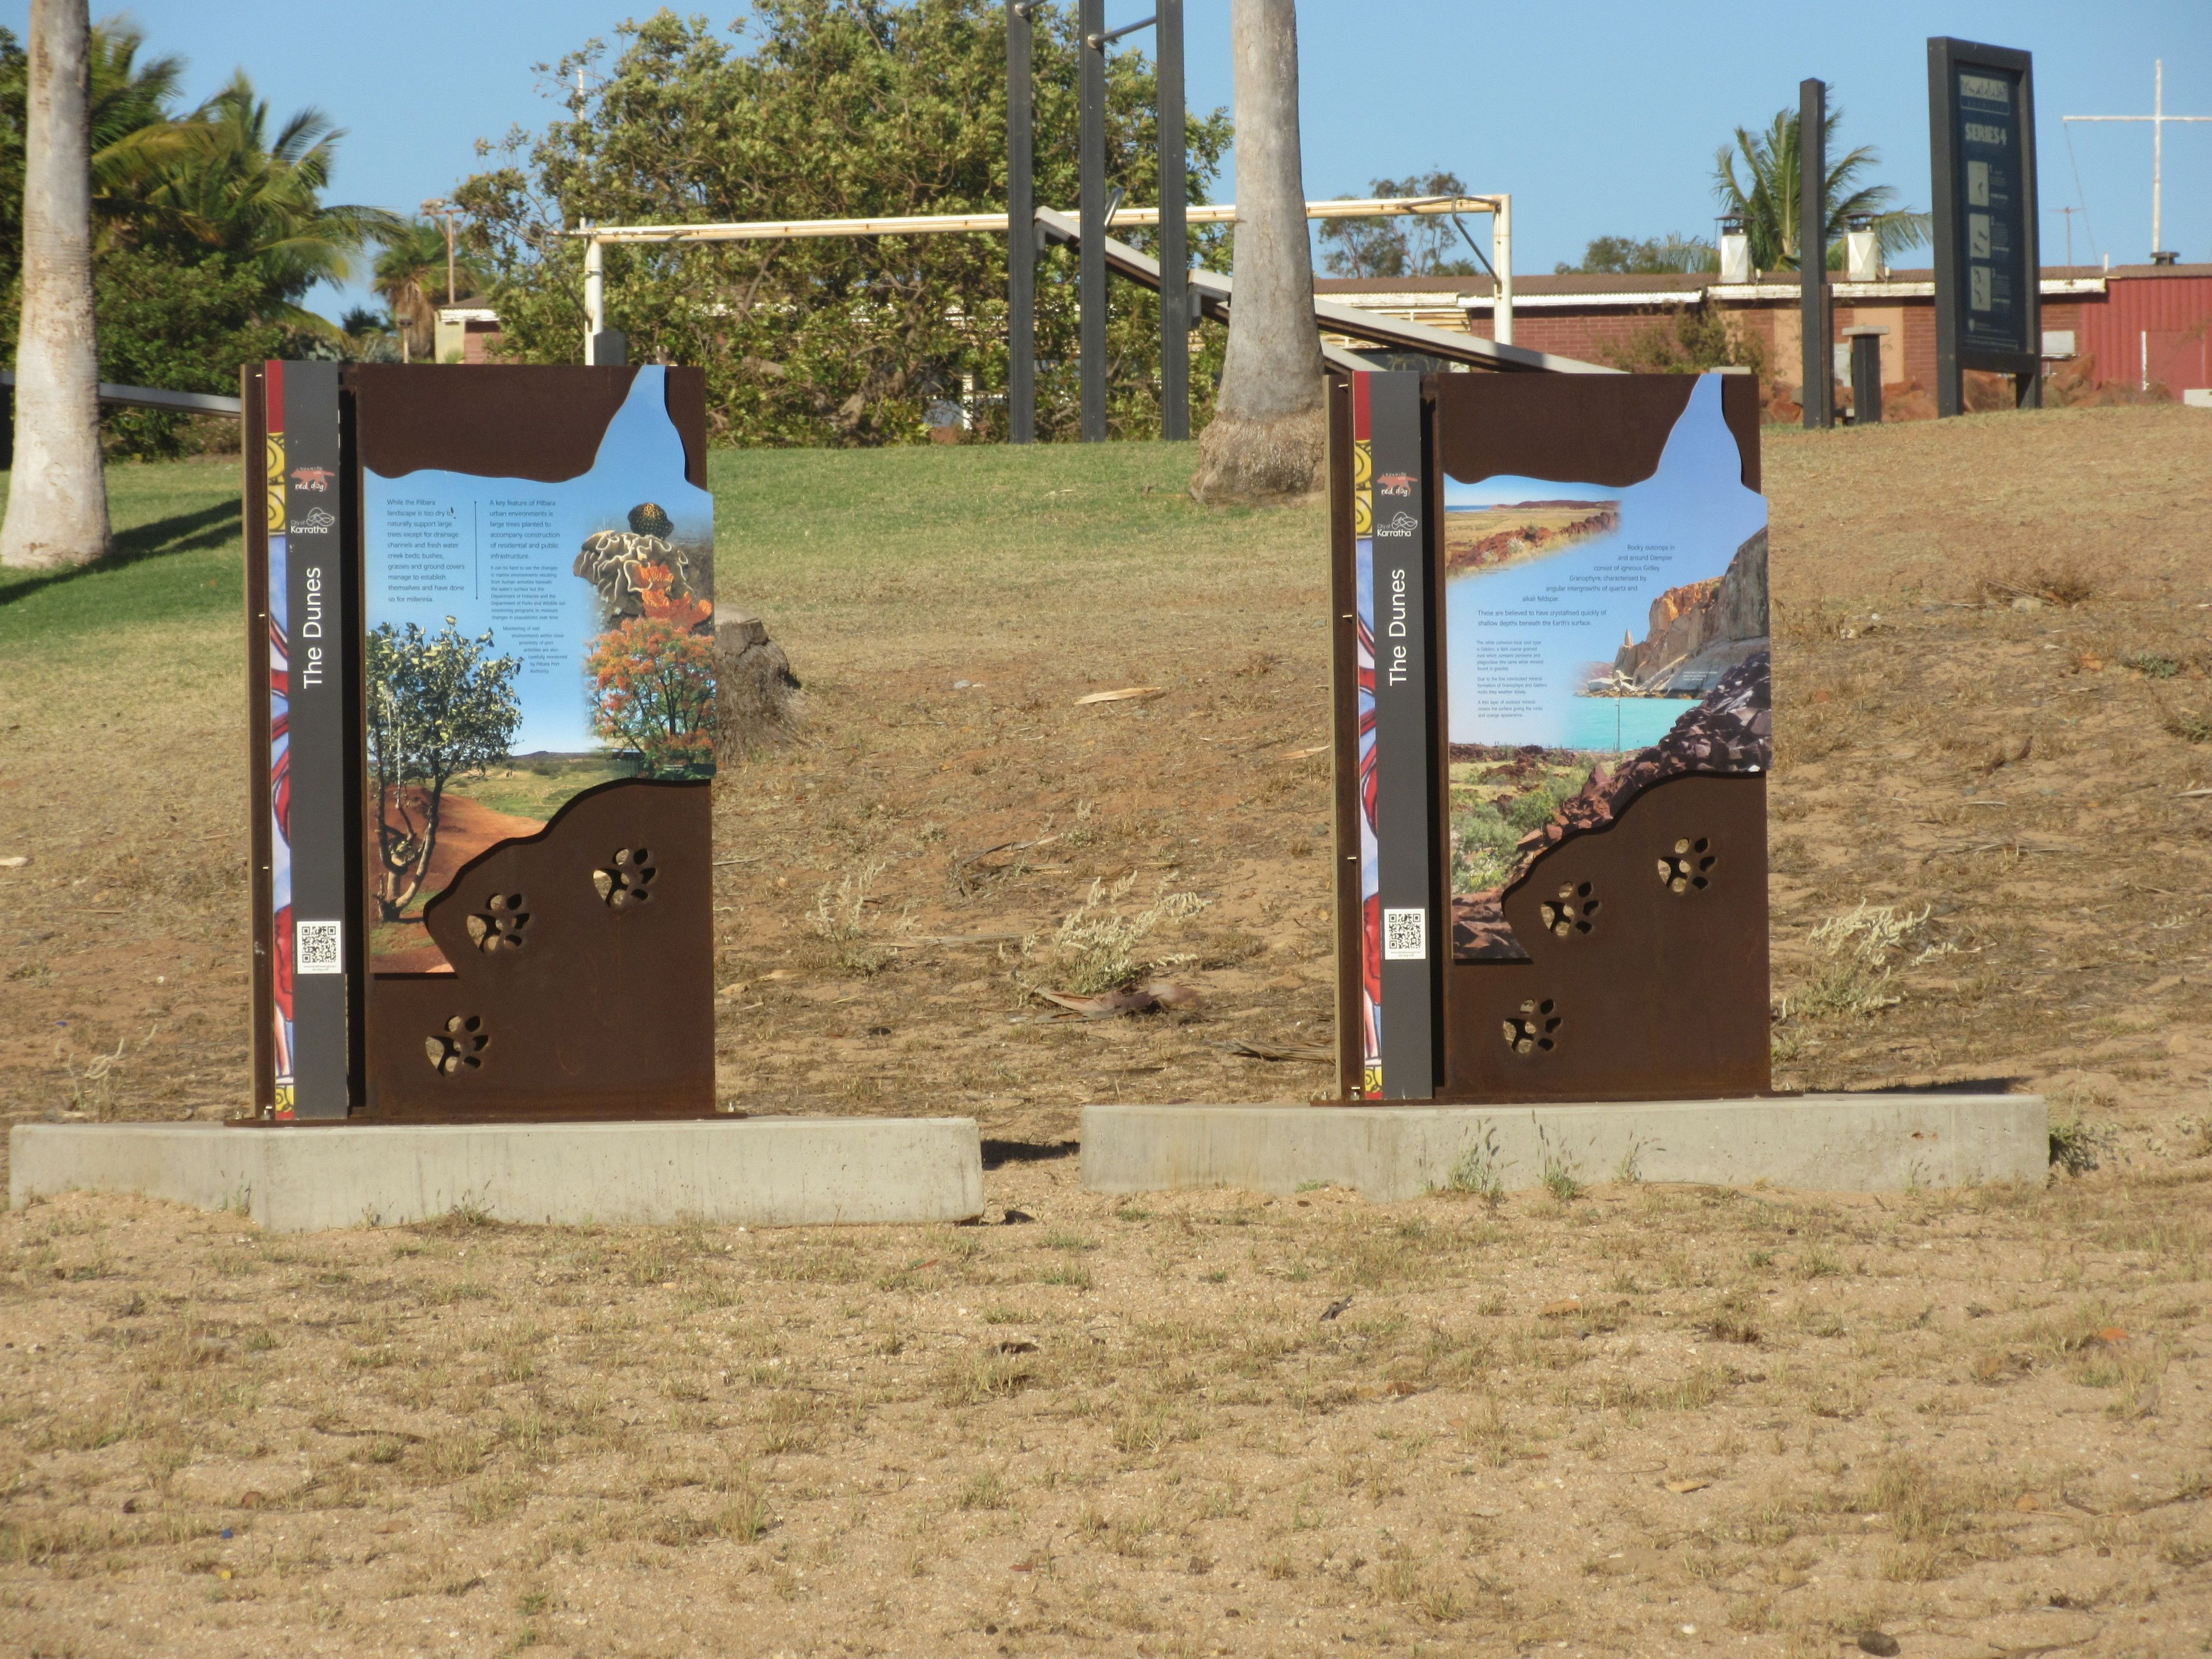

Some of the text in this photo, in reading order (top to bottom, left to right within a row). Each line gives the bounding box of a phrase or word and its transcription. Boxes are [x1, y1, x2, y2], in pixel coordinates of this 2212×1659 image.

[310, 482, 324, 492] dog
[1396, 487, 1408, 497] dog
[290, 525, 327, 533] Karratha
[1377, 529, 1411, 537] Karratha
[423, 563, 445, 571] ground
[303, 567, 323, 689] The Dunes
[1389, 569, 1407, 687] The Dunes
